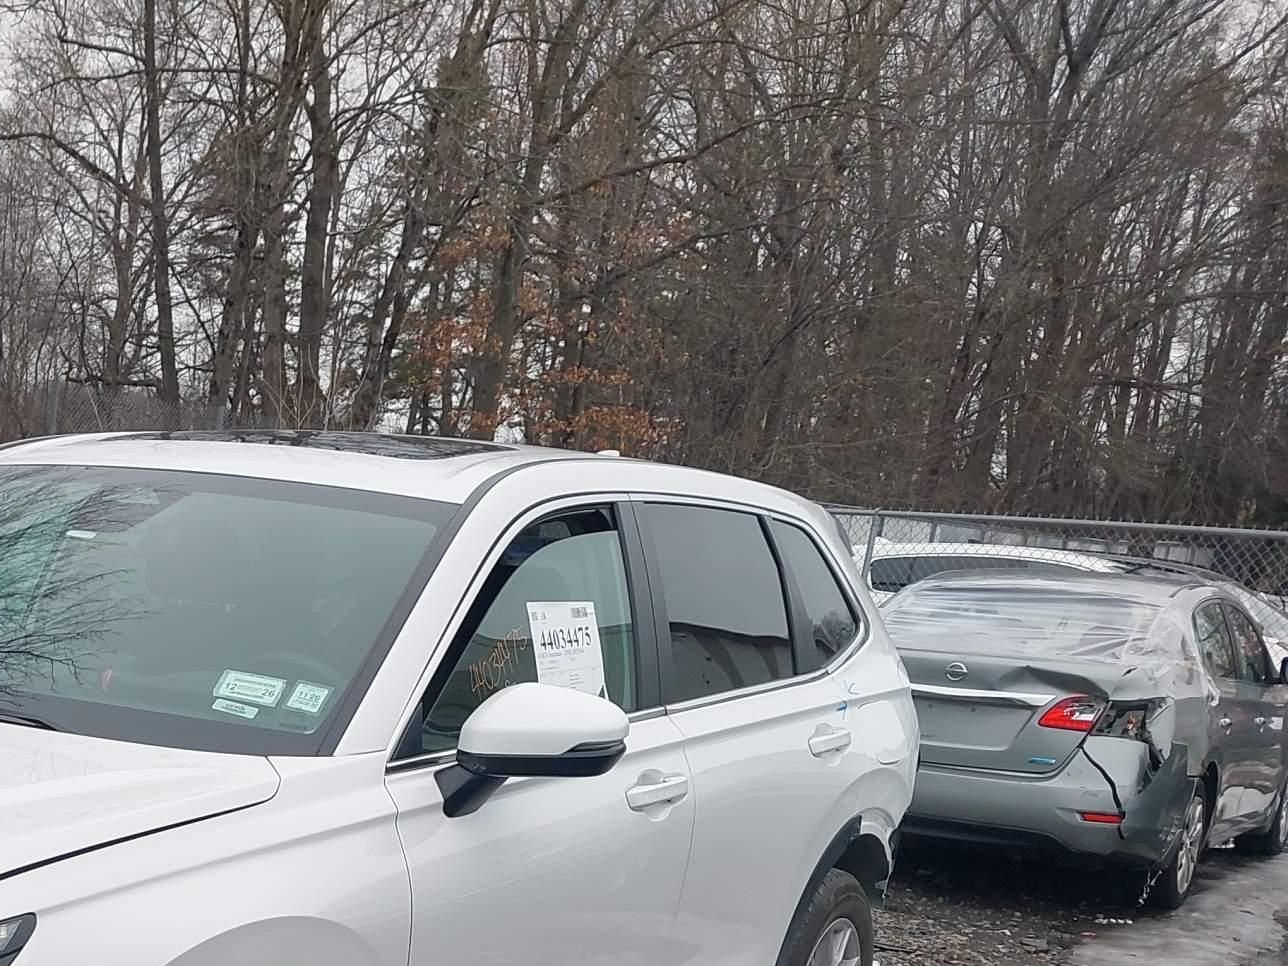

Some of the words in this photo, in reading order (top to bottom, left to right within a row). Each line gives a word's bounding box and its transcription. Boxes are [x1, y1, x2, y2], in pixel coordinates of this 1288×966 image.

[540, 625, 592, 651] 44034475
[224, 682, 238, 691] 12
[261, 688, 275, 698] 26
